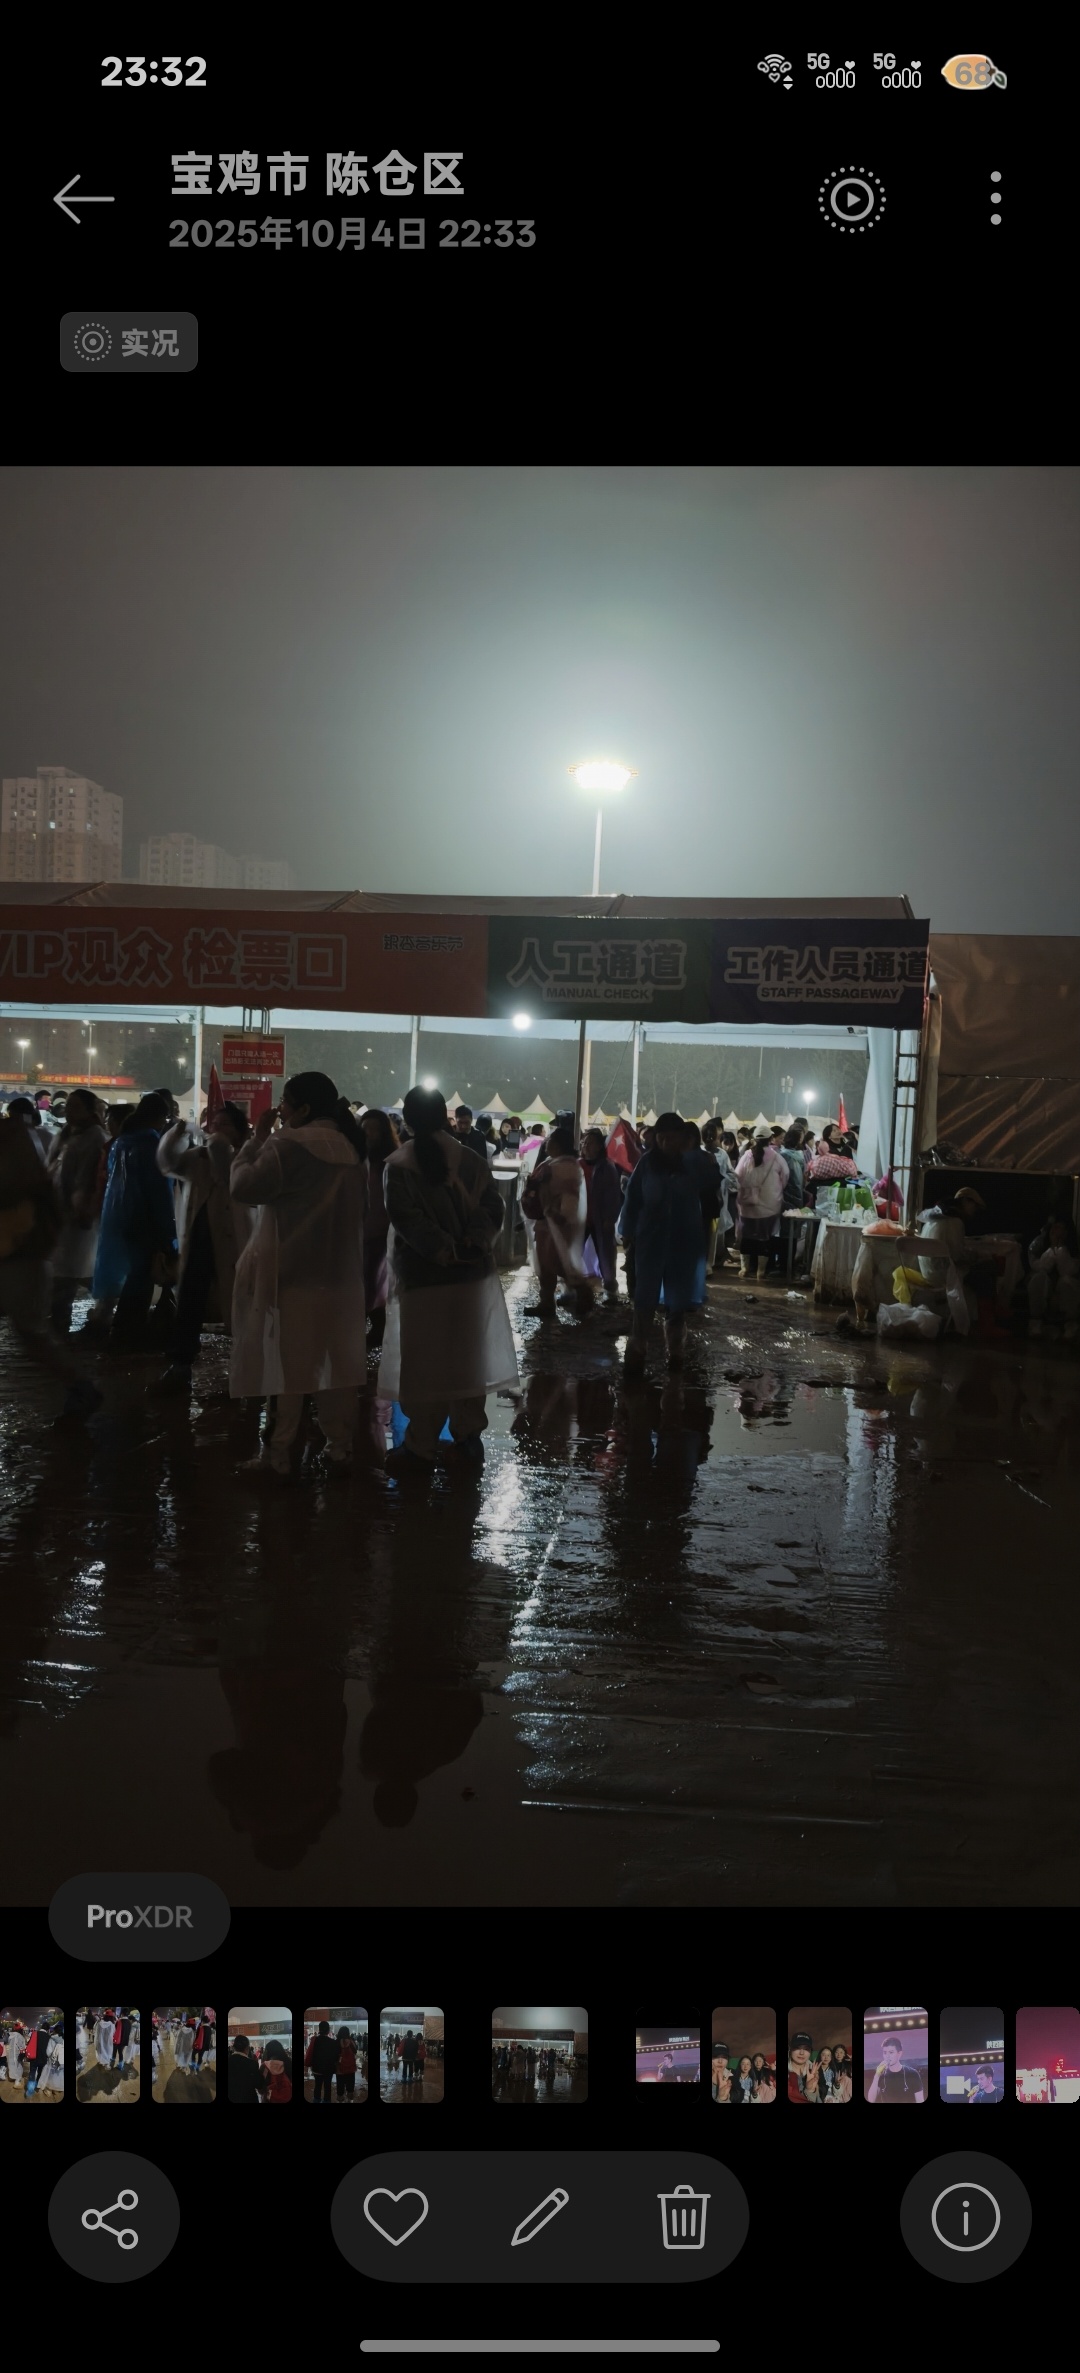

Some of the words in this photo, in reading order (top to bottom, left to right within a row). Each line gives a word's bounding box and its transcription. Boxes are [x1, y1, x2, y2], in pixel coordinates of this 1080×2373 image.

[183, 928, 347, 992] 检票口
[505, 938, 687, 991] 人工通道
[724, 945, 928, 985] 工作人员通道
[546, 988, 601, 1000] MANUAL
[604, 988, 650, 1001] CHECK
[761, 987, 803, 1000] STAFF
[806, 987, 900, 1000] PASSAGEWAY
